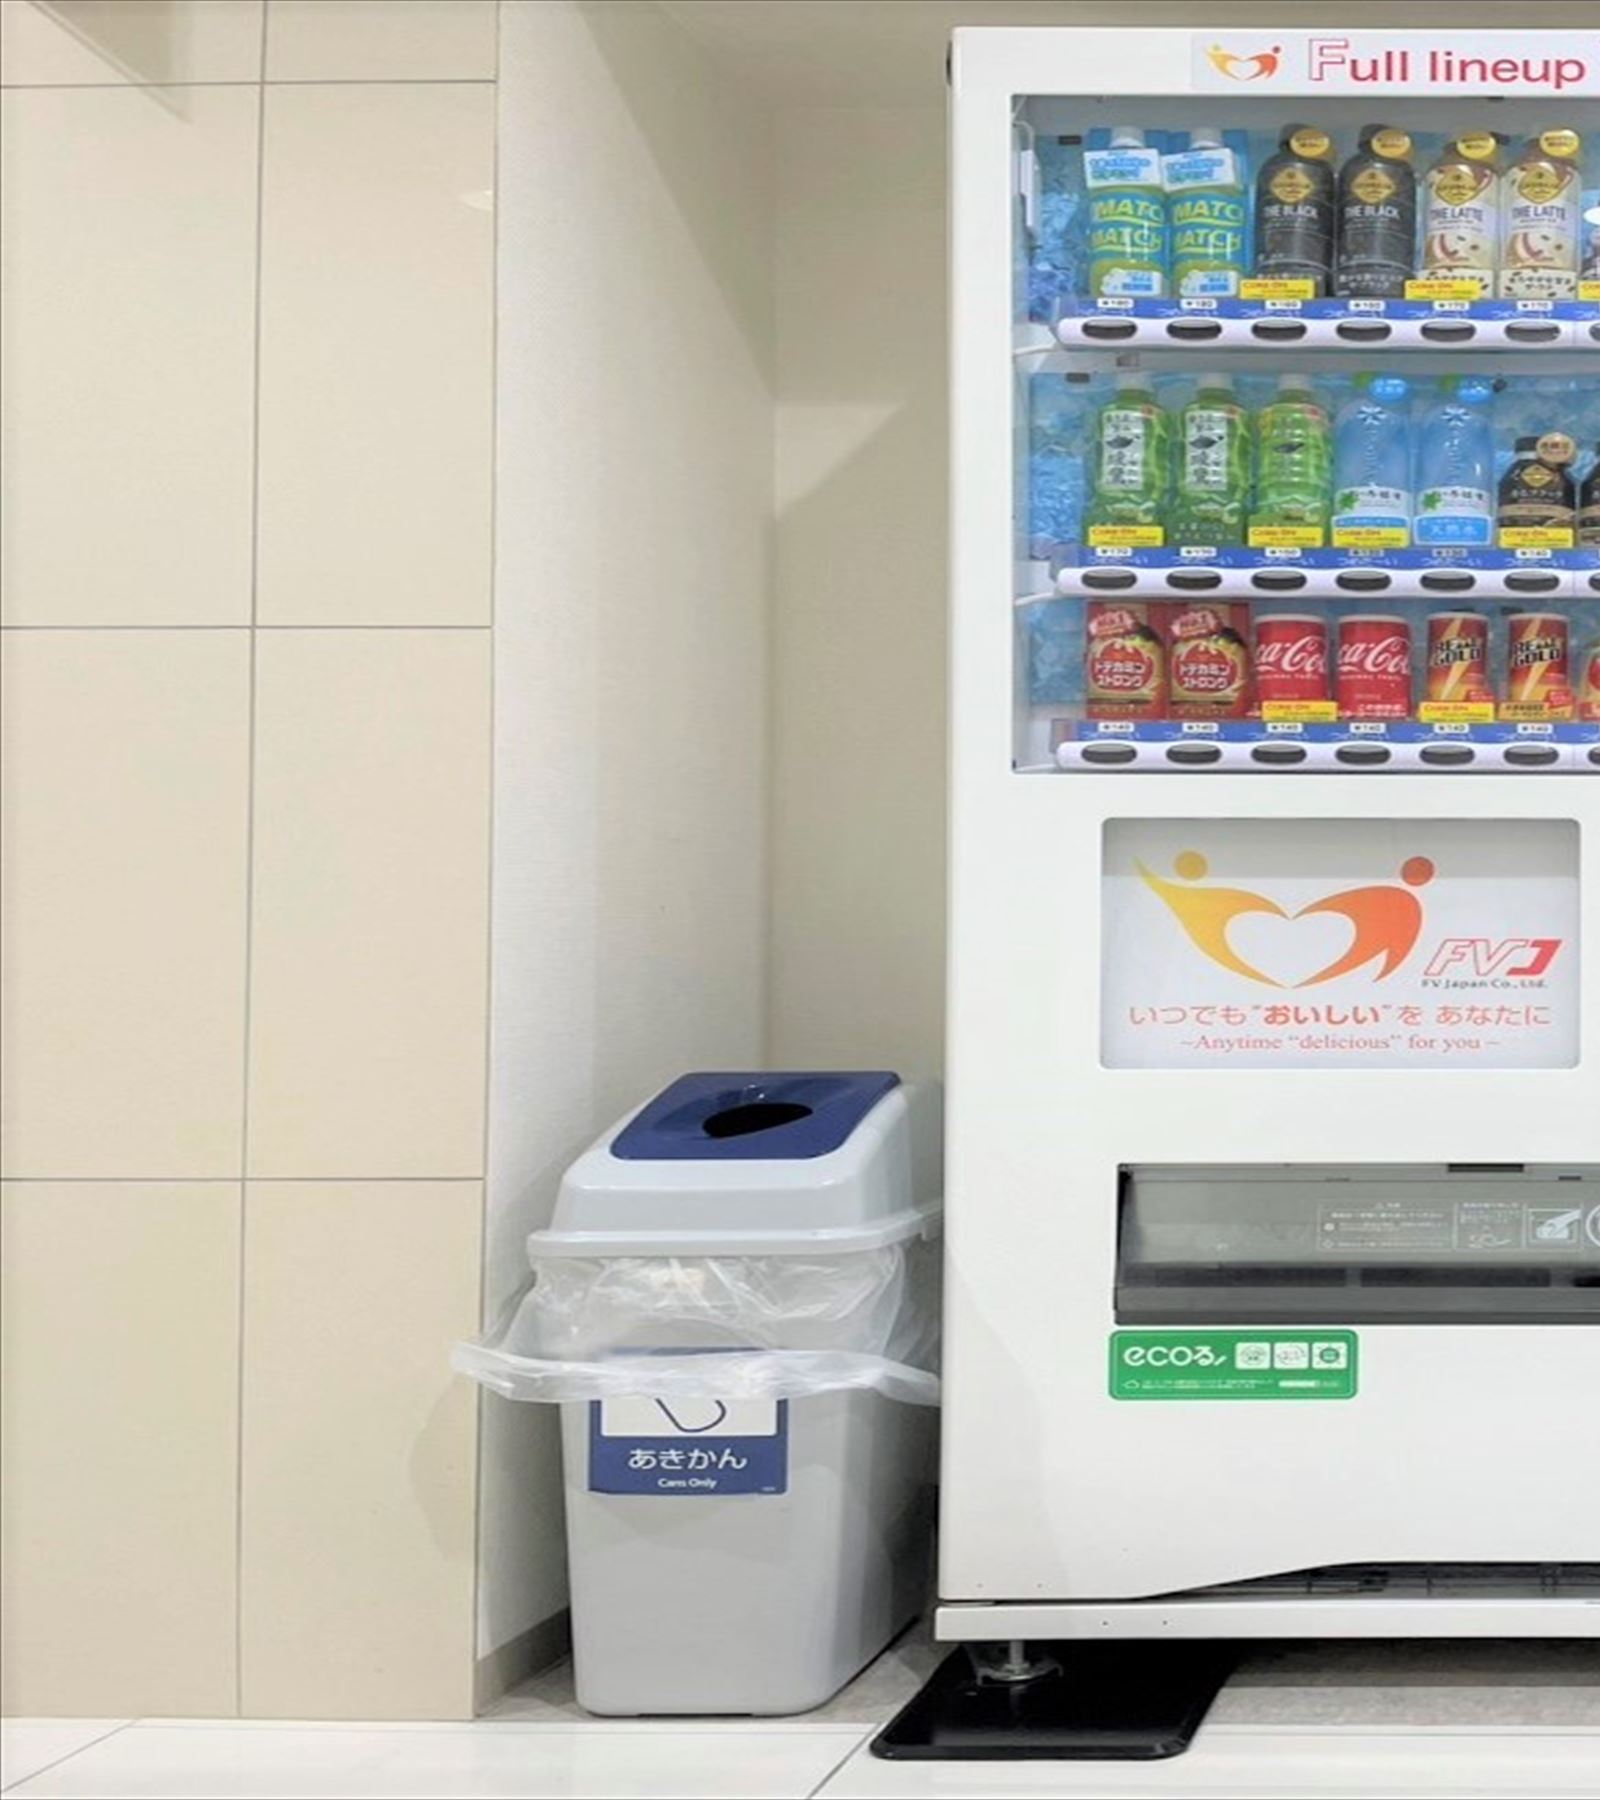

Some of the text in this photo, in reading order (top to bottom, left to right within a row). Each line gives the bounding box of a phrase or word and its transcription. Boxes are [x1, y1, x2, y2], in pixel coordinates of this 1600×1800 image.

[1308, 38, 1408, 81] Full
[1430, 50, 1586, 89] lineup
[1424, 938, 1563, 976] FVJ
[1444, 979, 1488, 991] Japan
[1435, 1004, 1551, 1027] あなたに
[1408, 1033, 1436, 1050] for
[1441, 1036, 1481, 1053] you
[628, 1447, 748, 1470] あきかん
[657, 1477, 718, 1489] Cans Only
